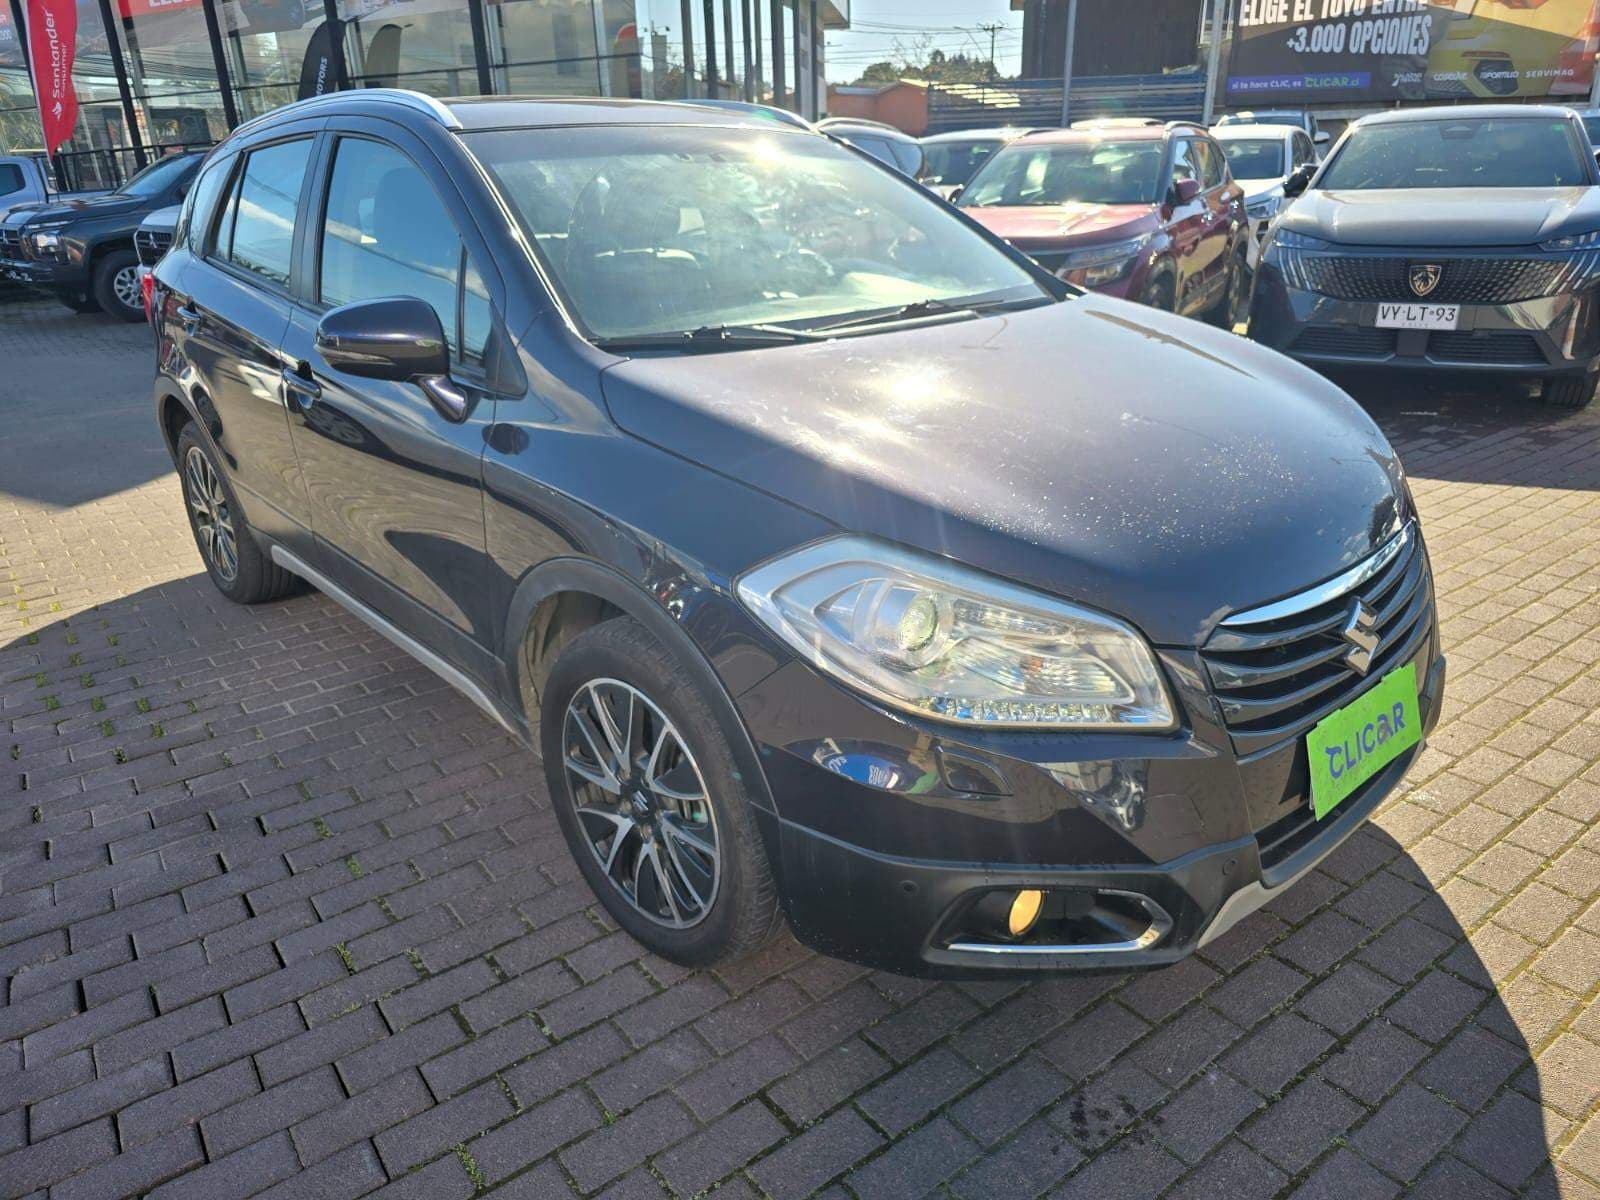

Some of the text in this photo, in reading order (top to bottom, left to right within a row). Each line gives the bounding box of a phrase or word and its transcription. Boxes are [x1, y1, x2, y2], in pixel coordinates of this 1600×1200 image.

[43, 6, 60, 98] Santander
[1286, 15, 1432, 55] +3.000 OPCIONES
[1526, 69, 1575, 78] SERVIMAG
